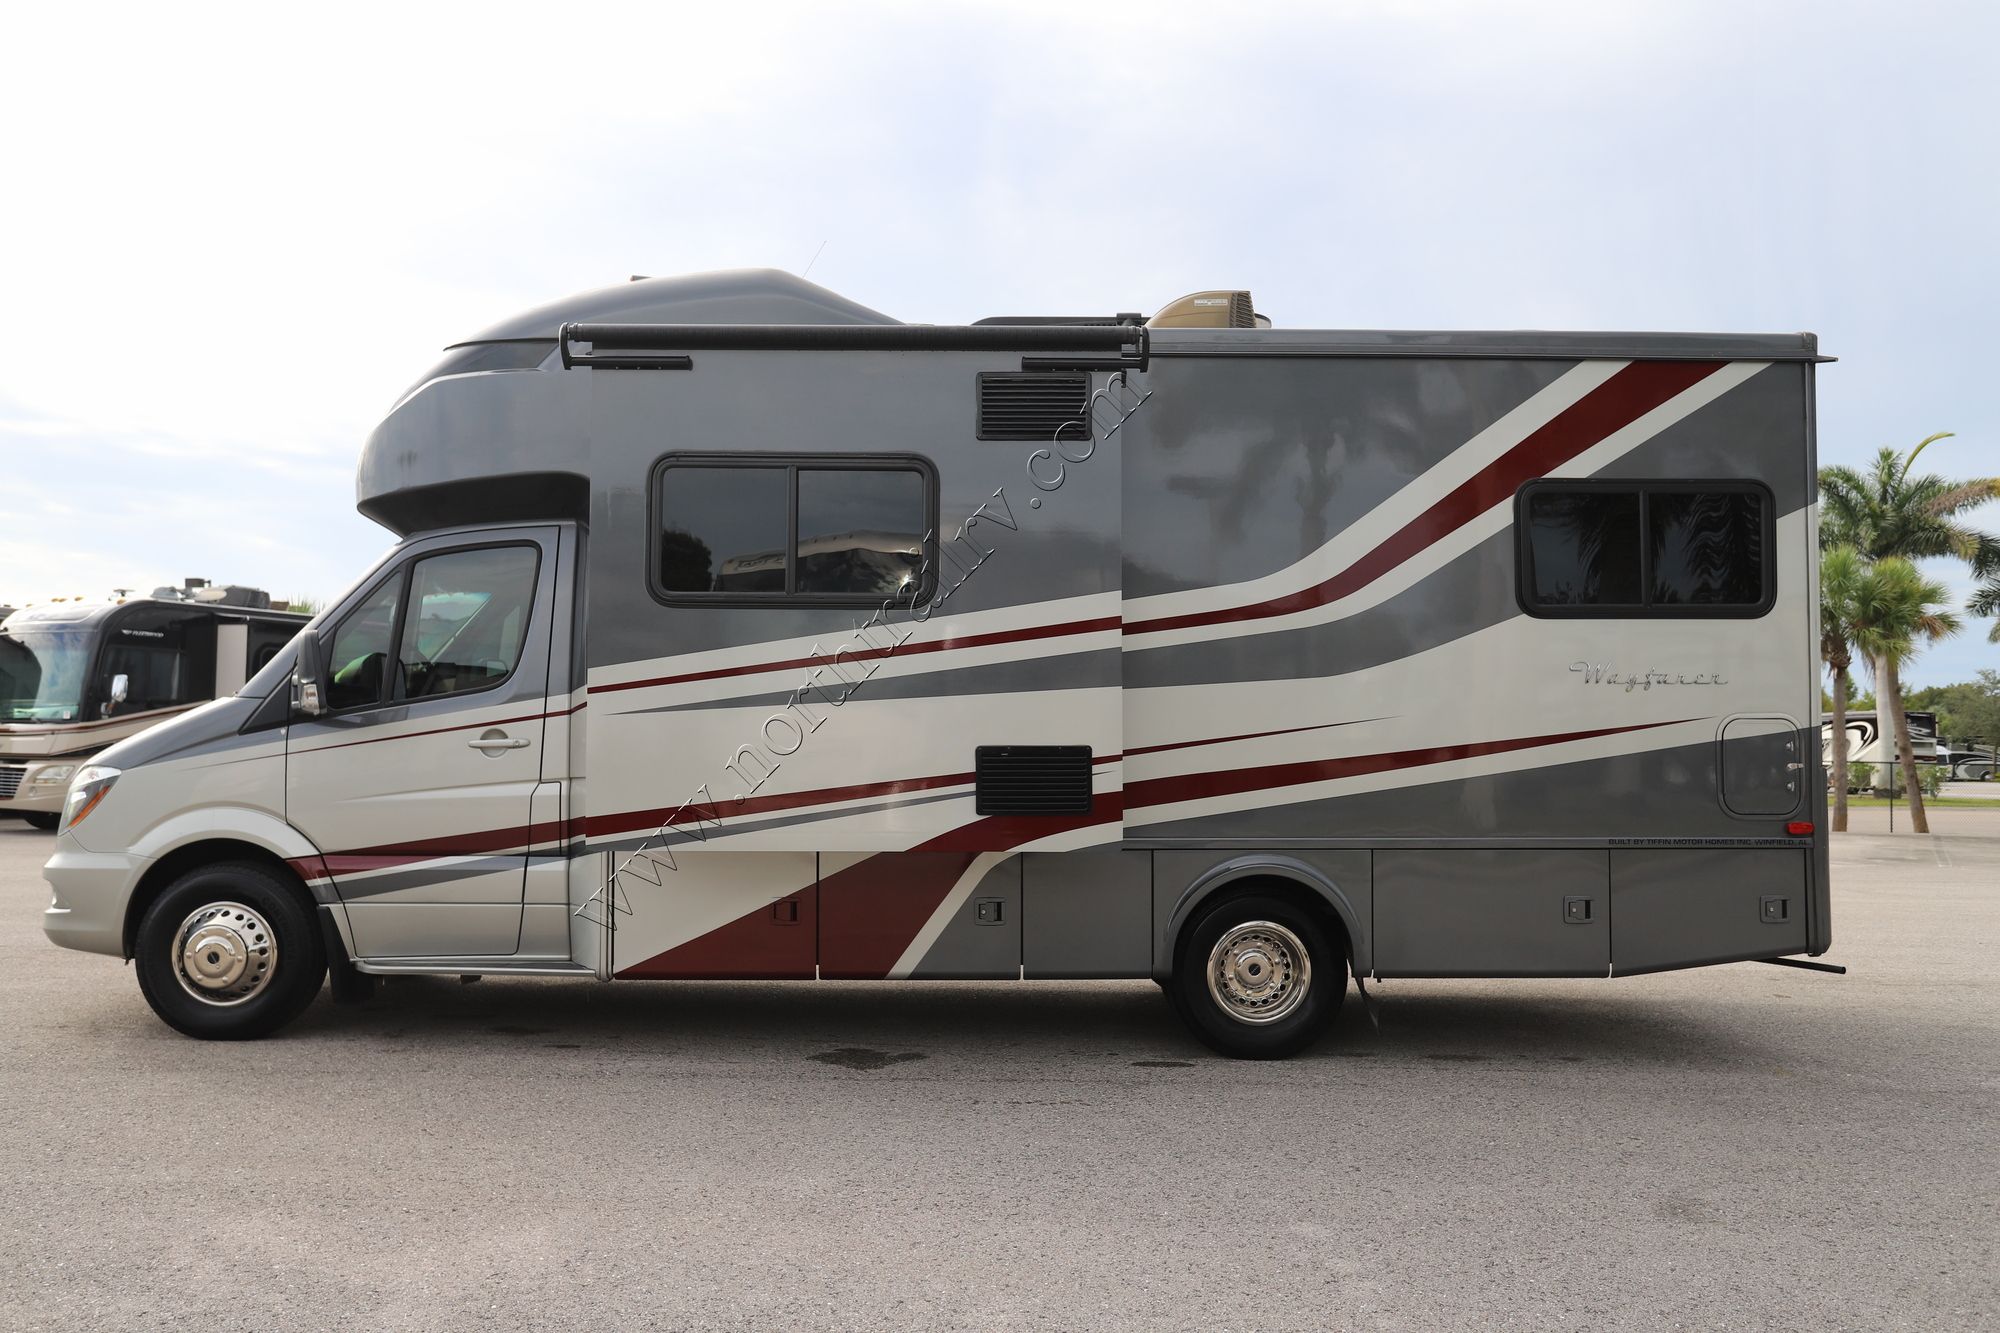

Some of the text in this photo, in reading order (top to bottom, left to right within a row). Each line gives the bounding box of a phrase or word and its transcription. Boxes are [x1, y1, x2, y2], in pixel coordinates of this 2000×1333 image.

[1568, 661, 1729, 693] Wayfarer
[1608, 838, 1632, 846] BUILT
[1633, 838, 1646, 846] BY
[1647, 838, 1672, 846] TIFFIN
[1673, 838, 1703, 846] MOTOR
[1705, 838, 1735, 846] HOMES
